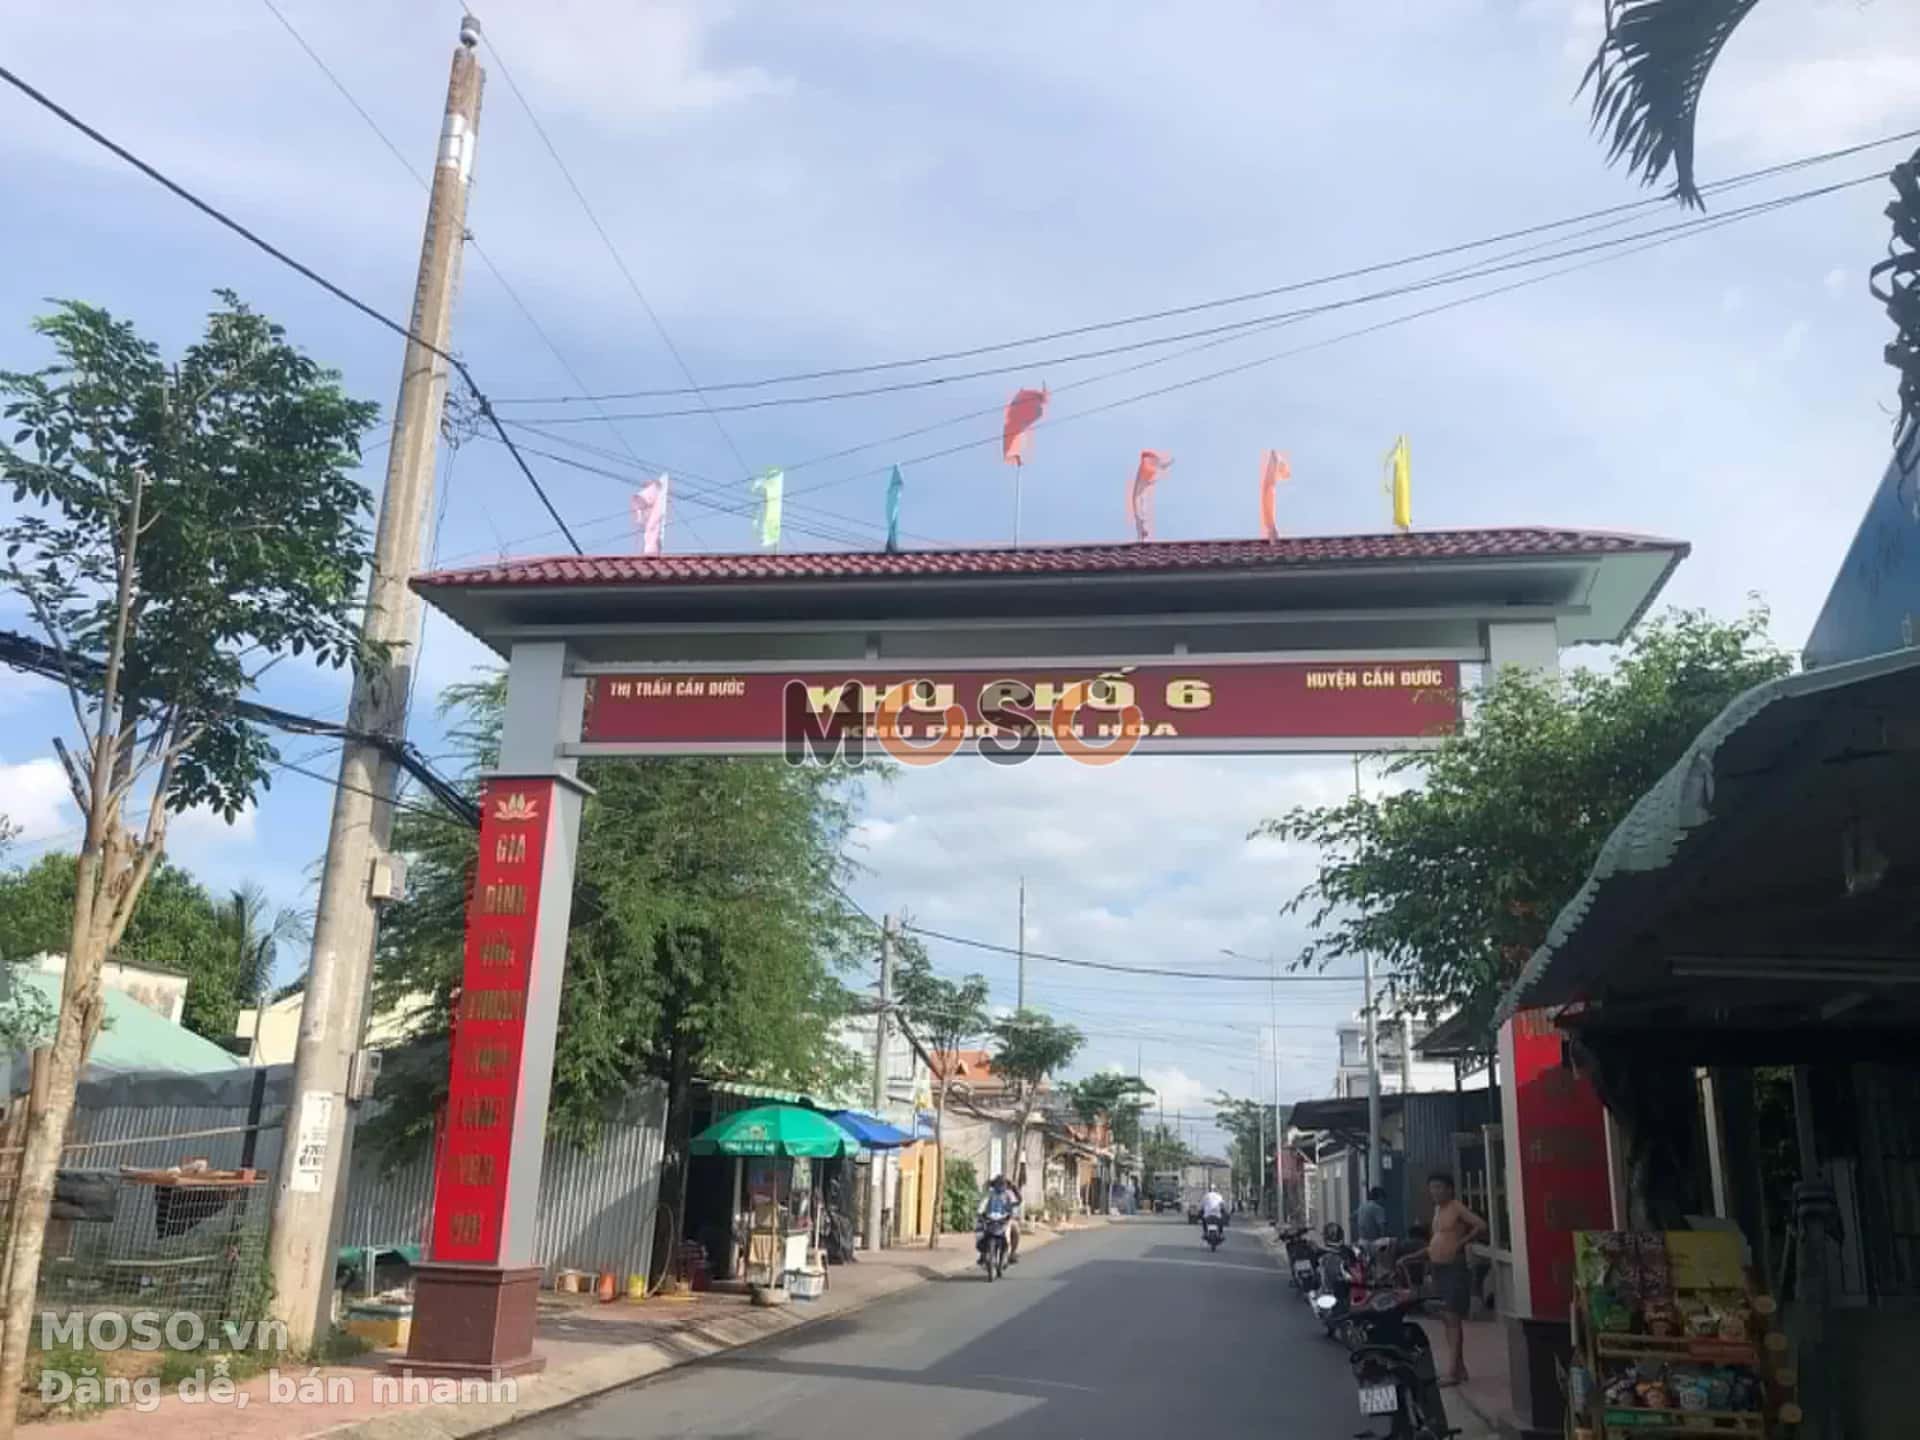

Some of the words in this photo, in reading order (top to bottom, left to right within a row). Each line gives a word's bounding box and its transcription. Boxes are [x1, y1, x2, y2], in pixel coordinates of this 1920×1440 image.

[805, 683, 955, 713] KHU
[982, 666, 1138, 712] PHỐ
[1165, 679, 1212, 709] 6
[1306, 668, 1357, 691] HUYỆN
[1400, 664, 1443, 687] ĐƯỚC
[841, 723, 913, 738] KHU
[496, 833, 527, 864] GIA
